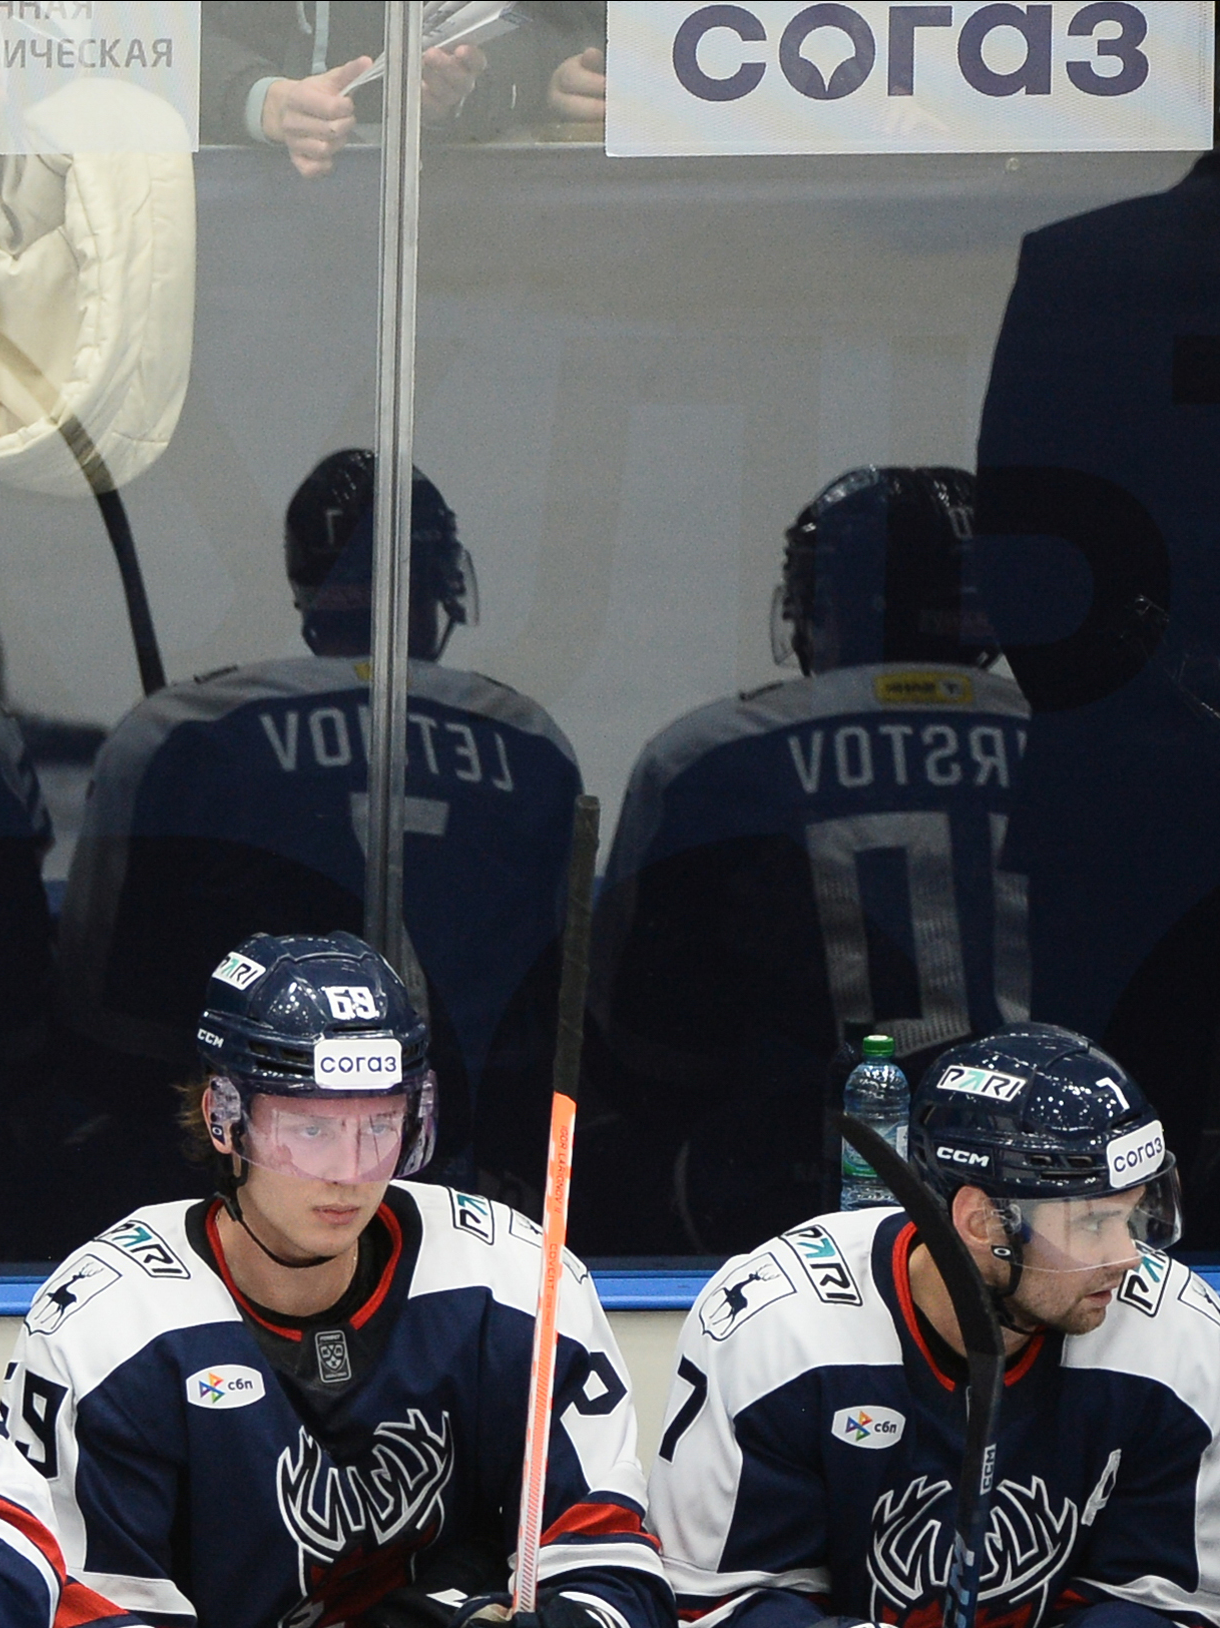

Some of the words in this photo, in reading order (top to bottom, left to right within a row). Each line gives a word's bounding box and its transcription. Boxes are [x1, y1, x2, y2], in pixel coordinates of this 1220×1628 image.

[672, 2, 1150, 101] согаз
[326, 986, 379, 1021] 69
[197, 1029, 225, 1049] CCM
[320, 1056, 397, 1073] согаз
[941, 1067, 1020, 1098] PARI
[1096, 1077, 1130, 1110] 7
[936, 1146, 989, 1168] CCM
[1113, 1136, 1163, 1173] согаз
[785, 1228, 858, 1301] PARI
[227, 1376, 254, 1392] сбп
[658, 1354, 709, 1463] 7
[874, 1420, 898, 1435] сбп
[983, 1446, 995, 1491] CCM
